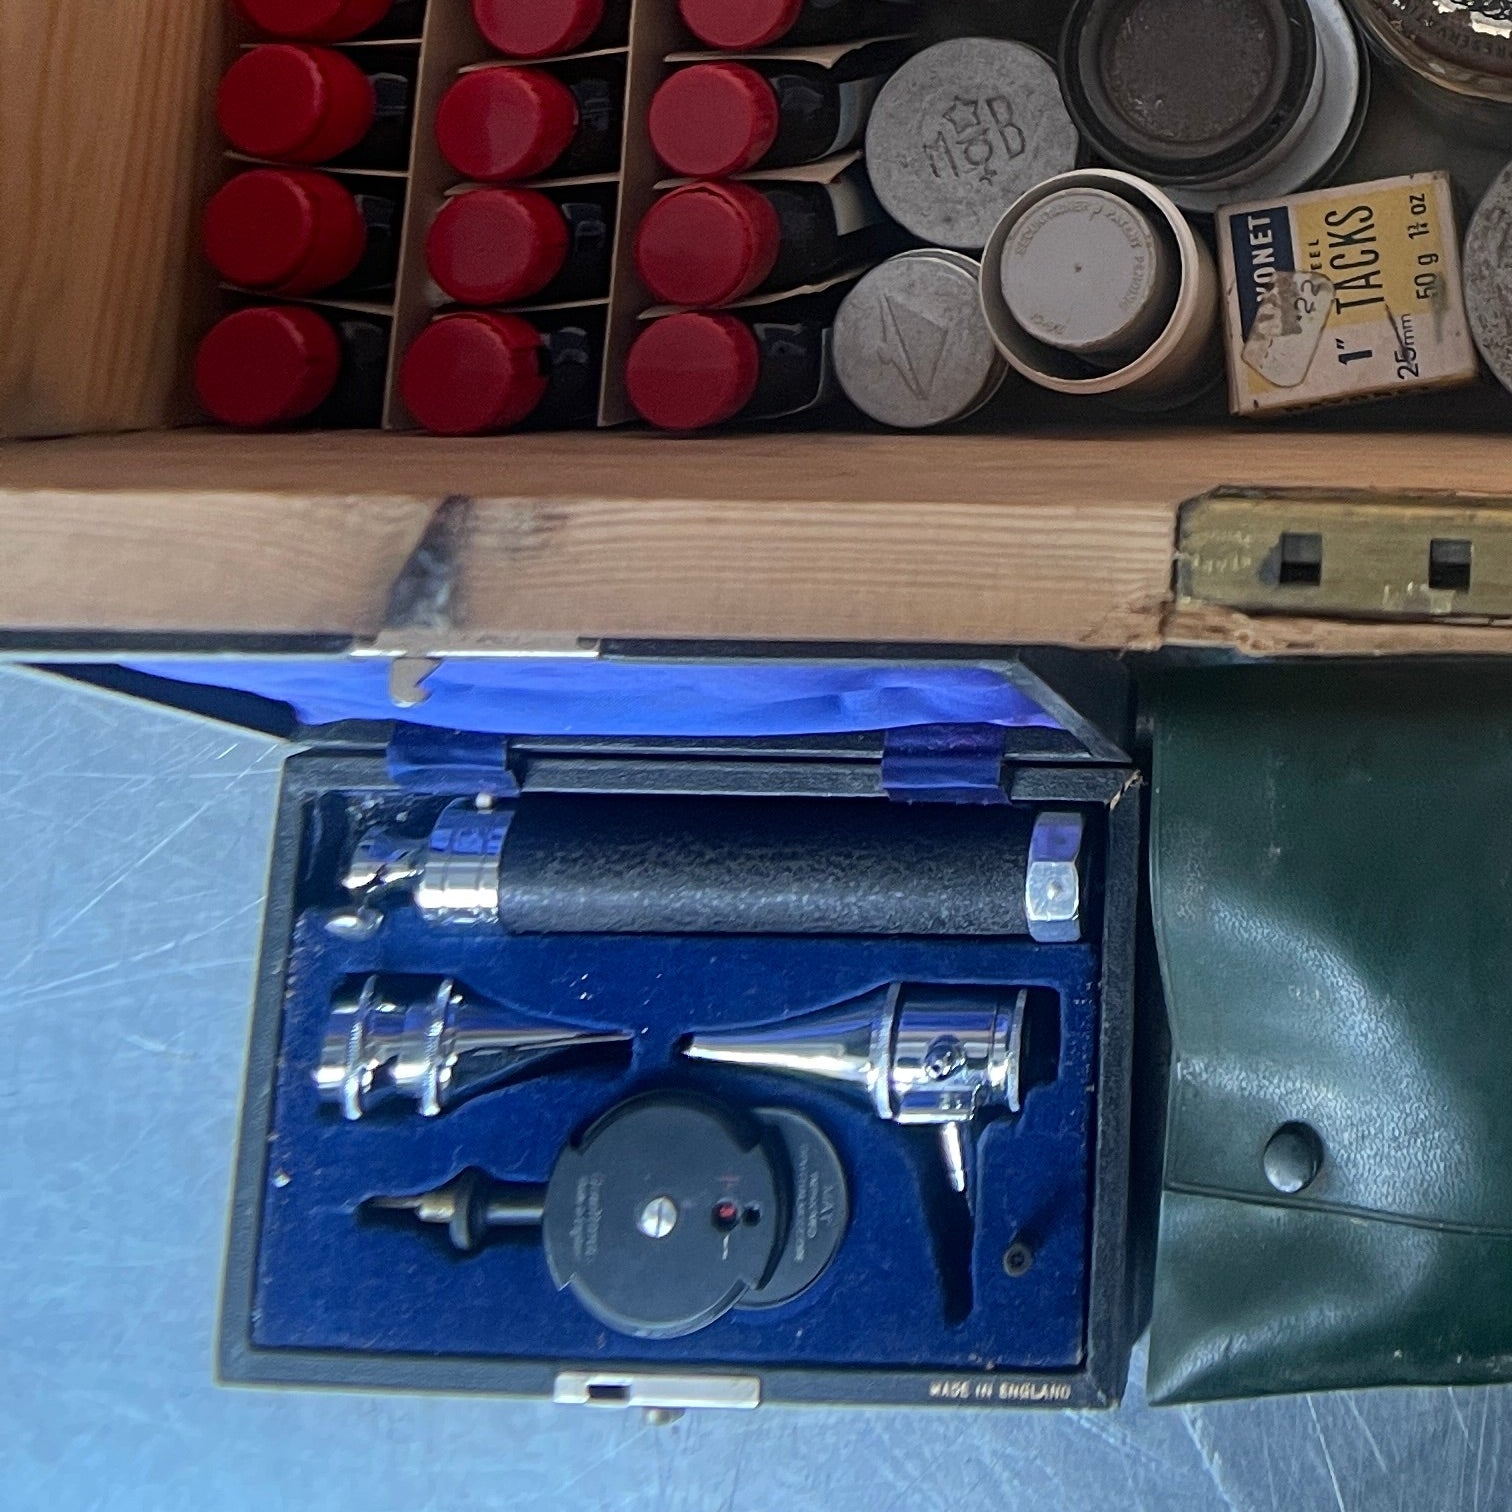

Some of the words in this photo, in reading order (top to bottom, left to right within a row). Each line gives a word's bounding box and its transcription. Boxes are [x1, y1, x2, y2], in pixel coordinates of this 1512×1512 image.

[1248, 215, 1276, 302] YONET
[1308, 239, 1323, 272] EEL
[1325, 205, 1386, 315] TACKS
[1418, 253, 1439, 266] g
[1415, 272, 1437, 299] 50
[929, 1381, 970, 1398] MADE
[975, 1382, 993, 1399] IN
[999, 1382, 1071, 1400] ENGLAND
